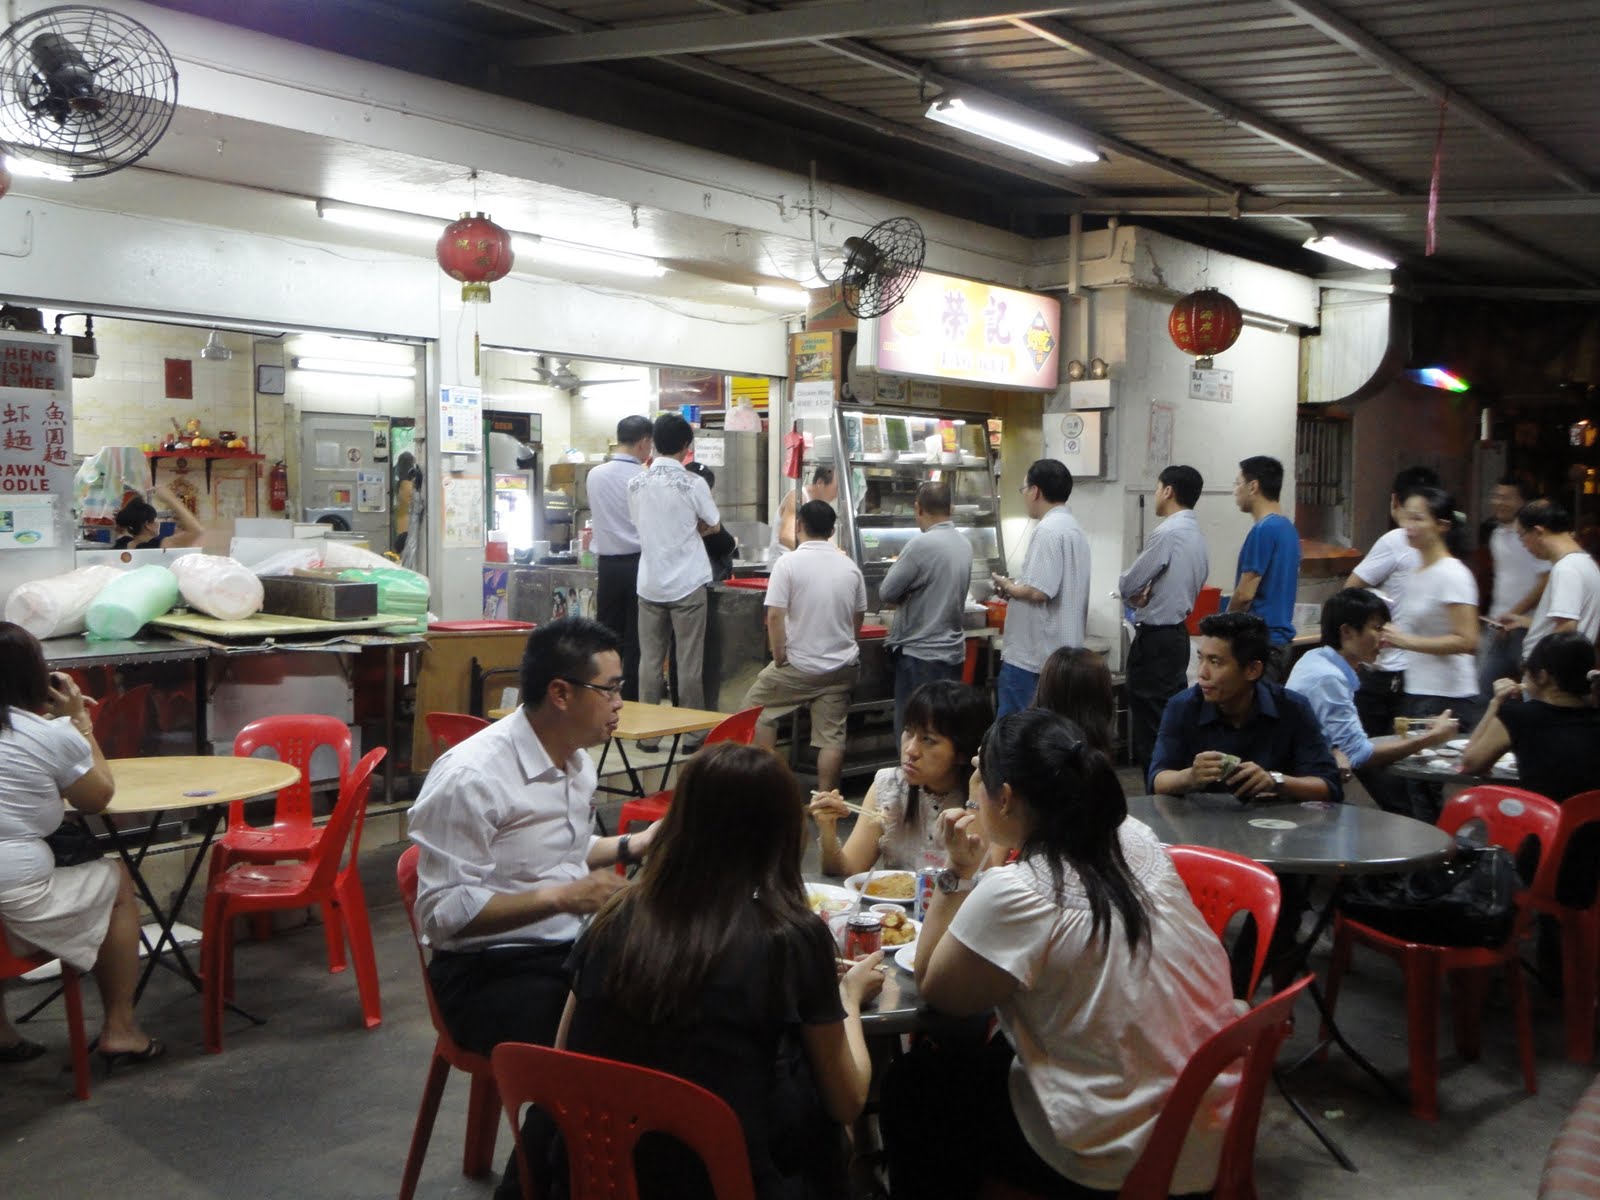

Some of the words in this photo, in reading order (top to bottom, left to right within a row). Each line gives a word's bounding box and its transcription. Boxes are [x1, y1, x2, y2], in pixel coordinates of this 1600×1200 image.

[5, 347, 57, 363] HENG
[19, 376, 56, 390] MEE
[0, 464, 46, 477] AWN
